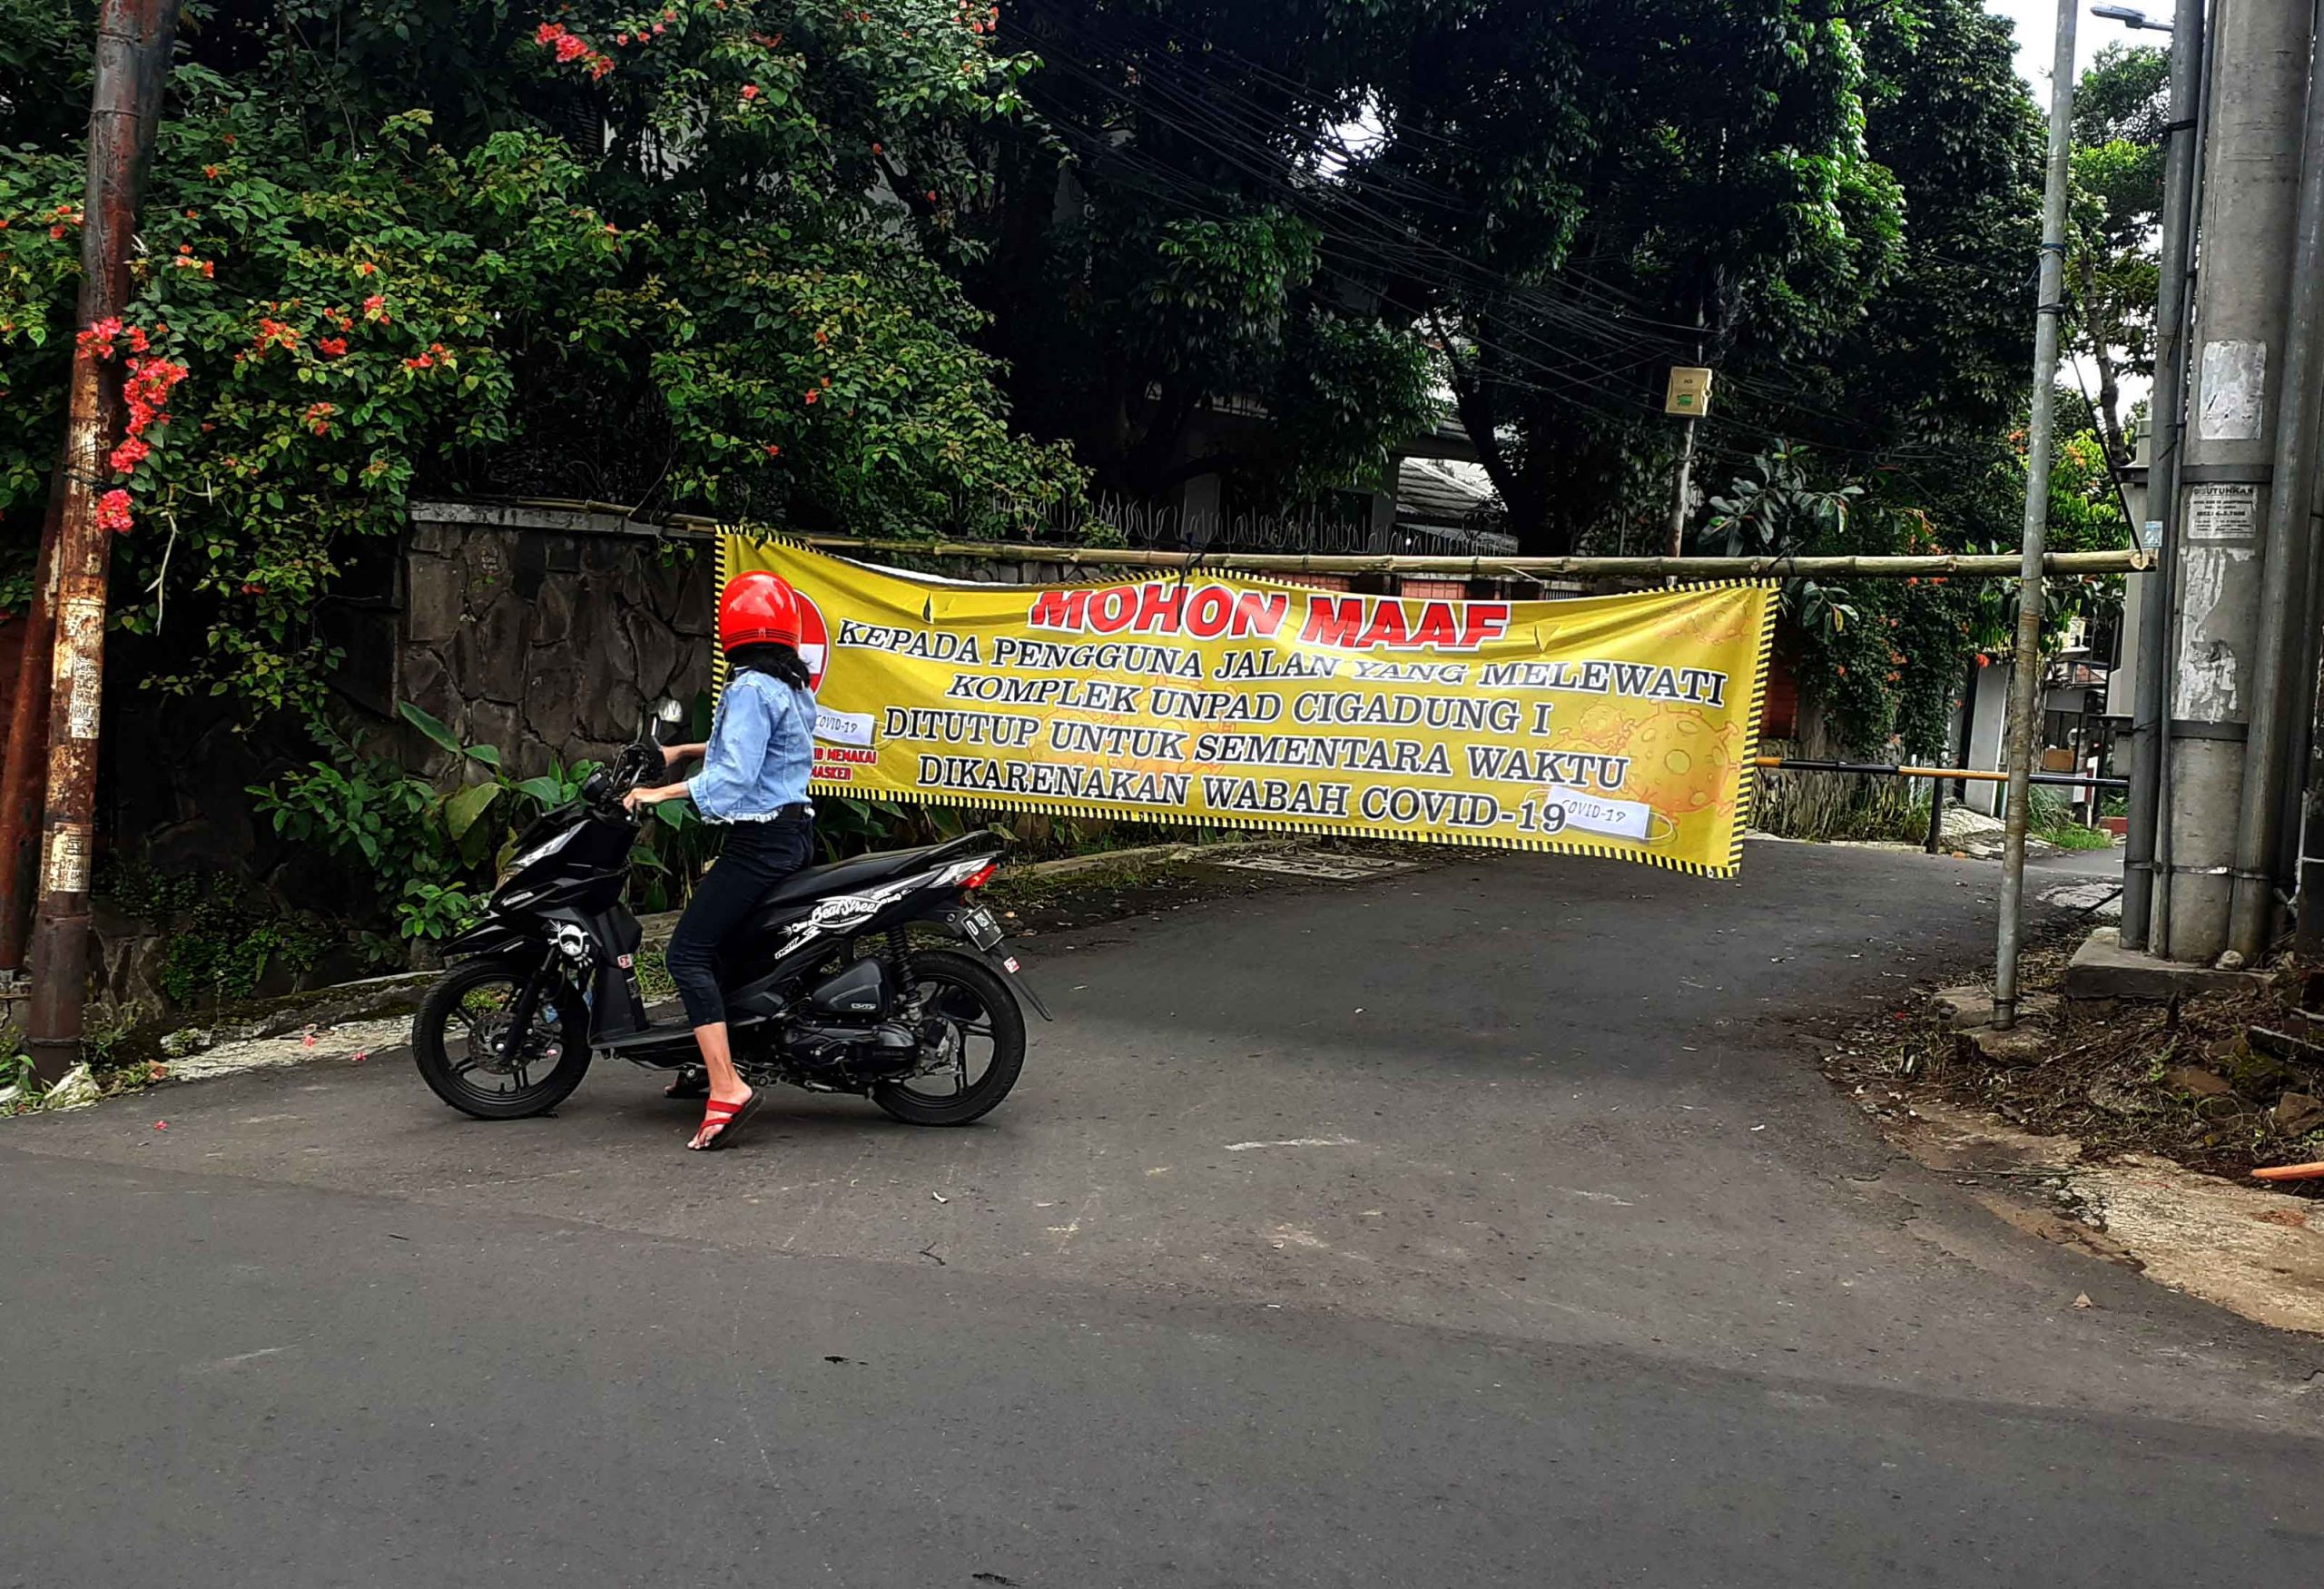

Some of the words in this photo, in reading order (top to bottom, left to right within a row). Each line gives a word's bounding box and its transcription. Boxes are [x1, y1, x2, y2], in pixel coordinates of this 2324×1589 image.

[1029, 583, 1288, 637] MOHON
[1299, 597, 1510, 649] MAAF
[836, 619, 980, 664] KEPADA
[991, 638, 1203, 677] PENGGUNA
[1214, 650, 1340, 679] JALAN
[1354, 660, 1468, 683] YANG
[1480, 662, 1727, 706] MELEWATI
[947, 675, 1139, 713] KOMPLEK
[1151, 689, 1281, 721] UNPAD
[1294, 693, 1520, 731] CIGADUNG
[1531, 704, 1551, 734] I
[882, 707, 1039, 745] DITUTUP
[1051, 721, 1188, 760] UNTUK
[1194, 735, 1451, 775] SEMENTARA
[1467, 746, 1629, 788] WAKTU
[917, 755, 1191, 804] DIKARENAKAN
[1203, 777, 1350, 816] WABAH
[1362, 787, 1565, 832] COVID-19
